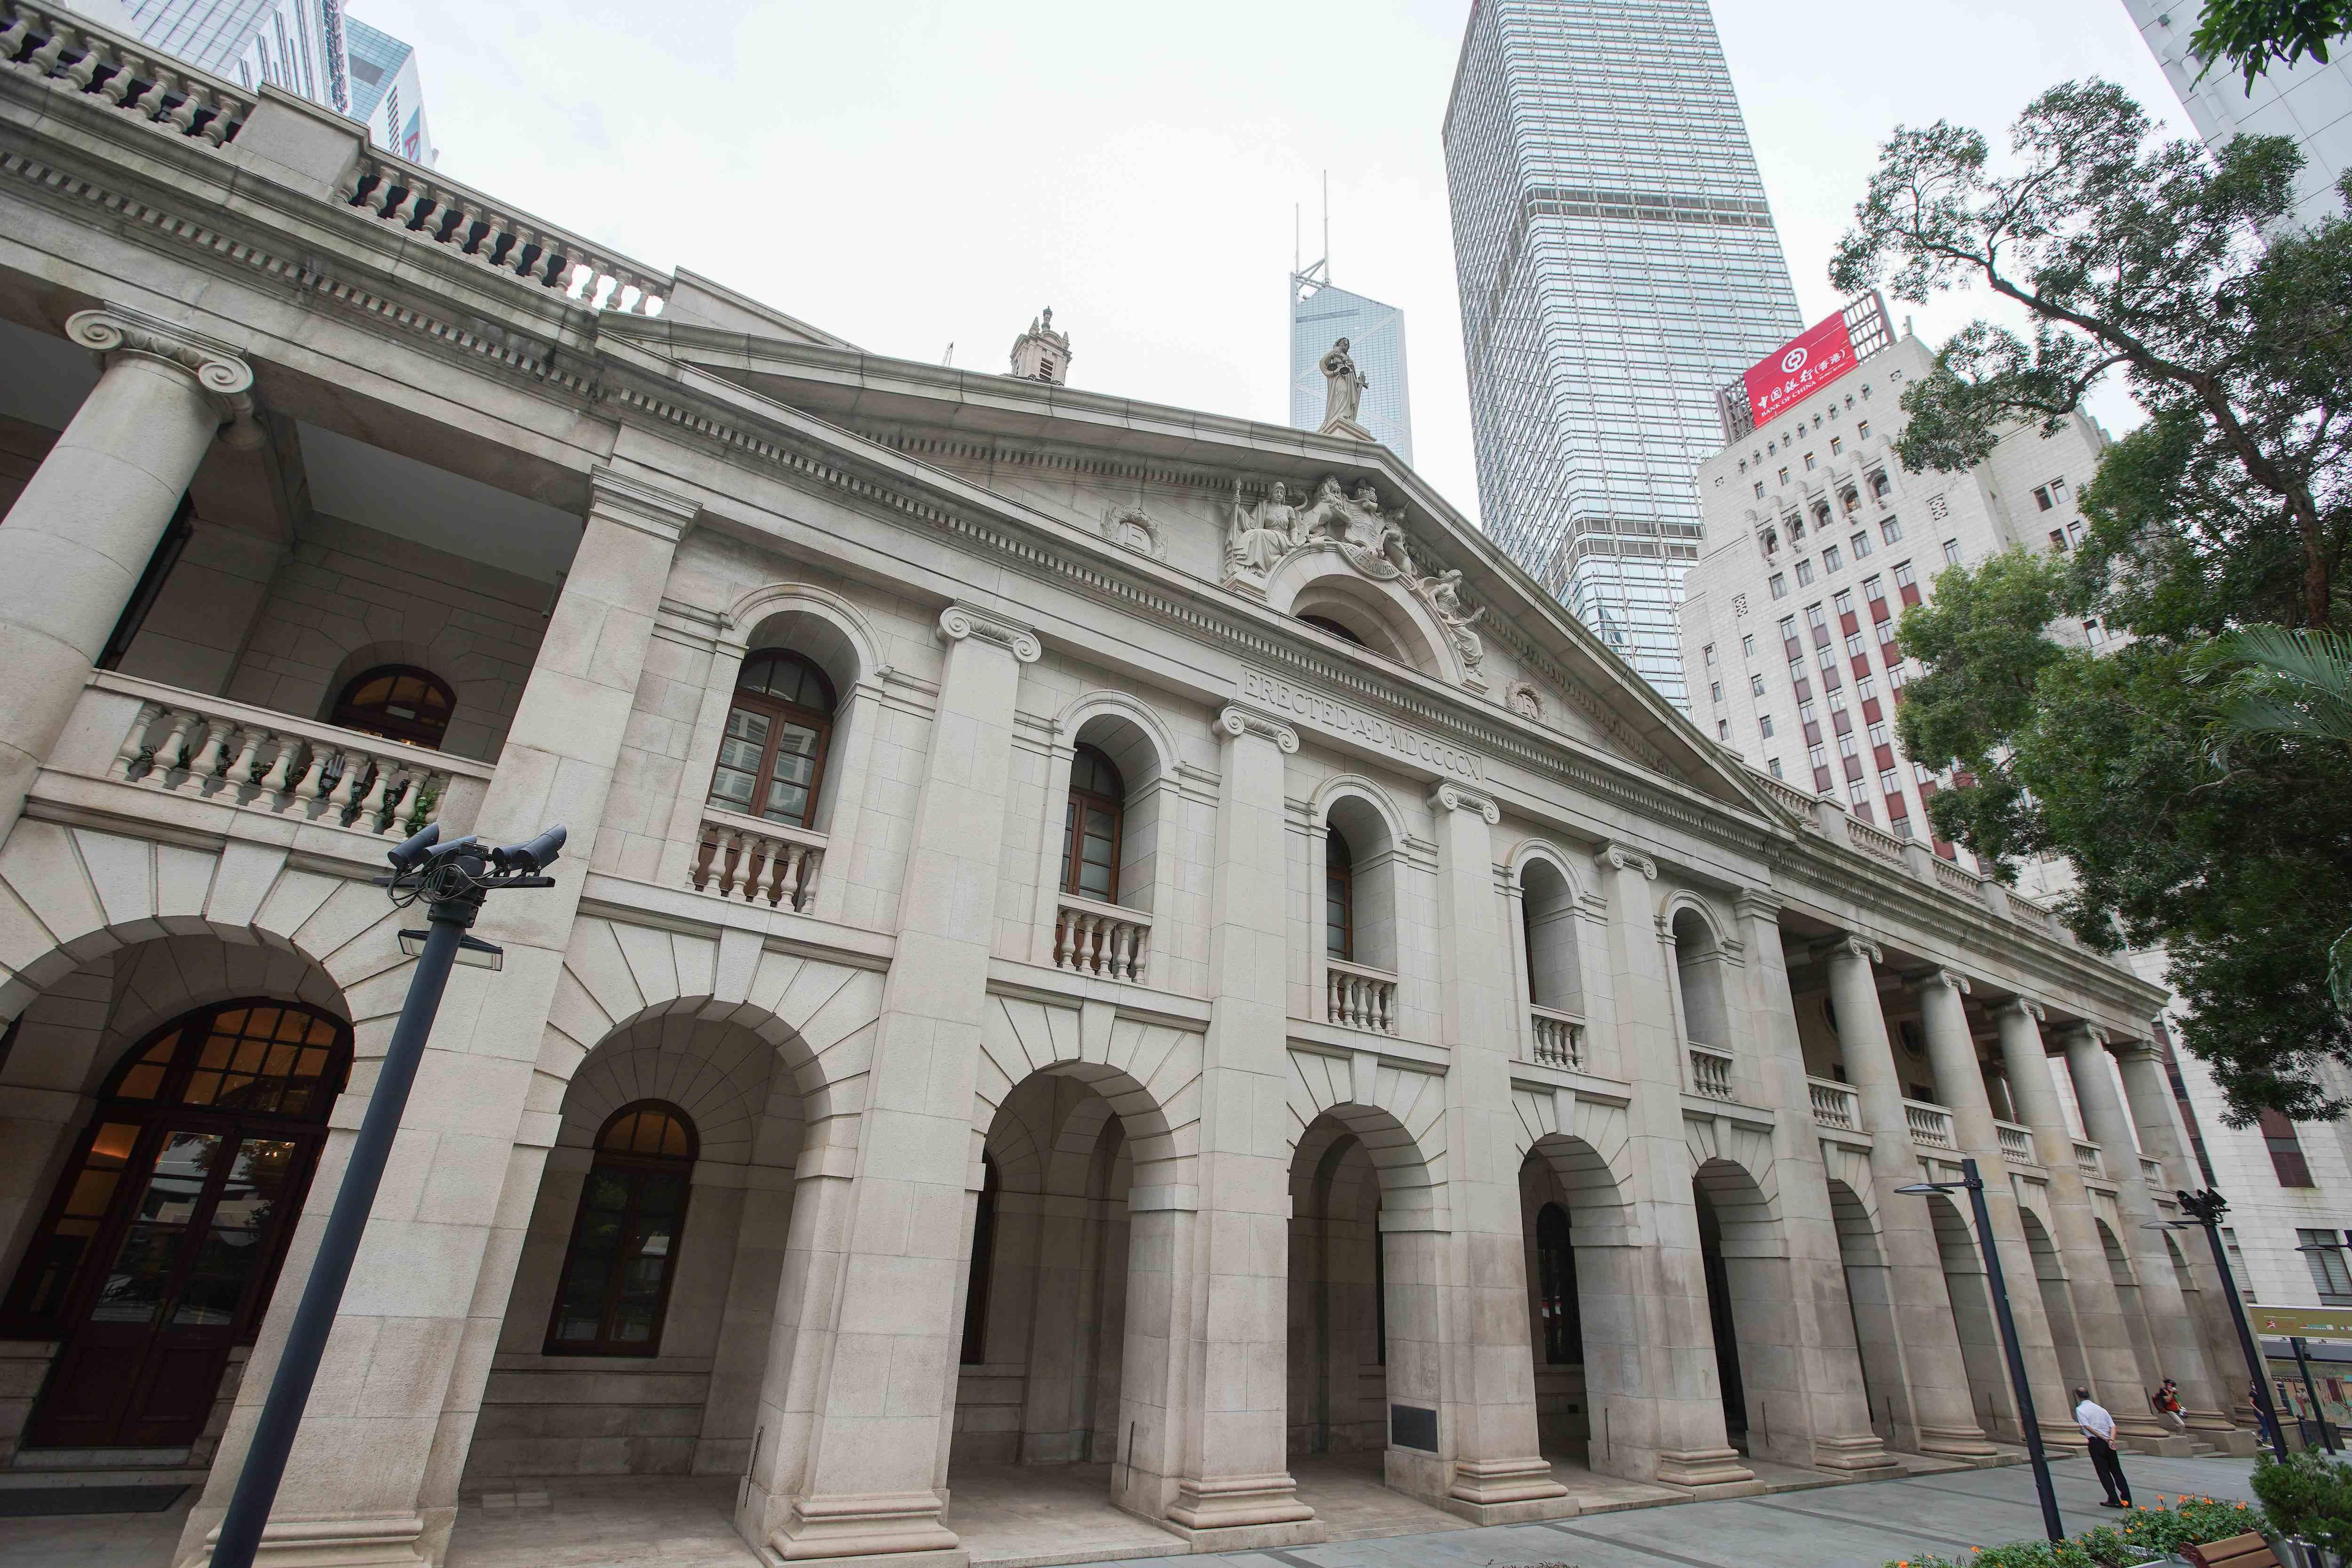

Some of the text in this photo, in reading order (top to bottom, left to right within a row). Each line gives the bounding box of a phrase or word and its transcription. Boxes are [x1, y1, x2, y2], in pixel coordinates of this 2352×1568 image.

[1761, 402, 1781, 417] BANK
[1781, 396, 1791, 405] OF
[1792, 380, 1816, 398] CHINA
[1245, 671, 1350, 730] ERECTED
[1390, 726, 1479, 780] MDCCCCX
